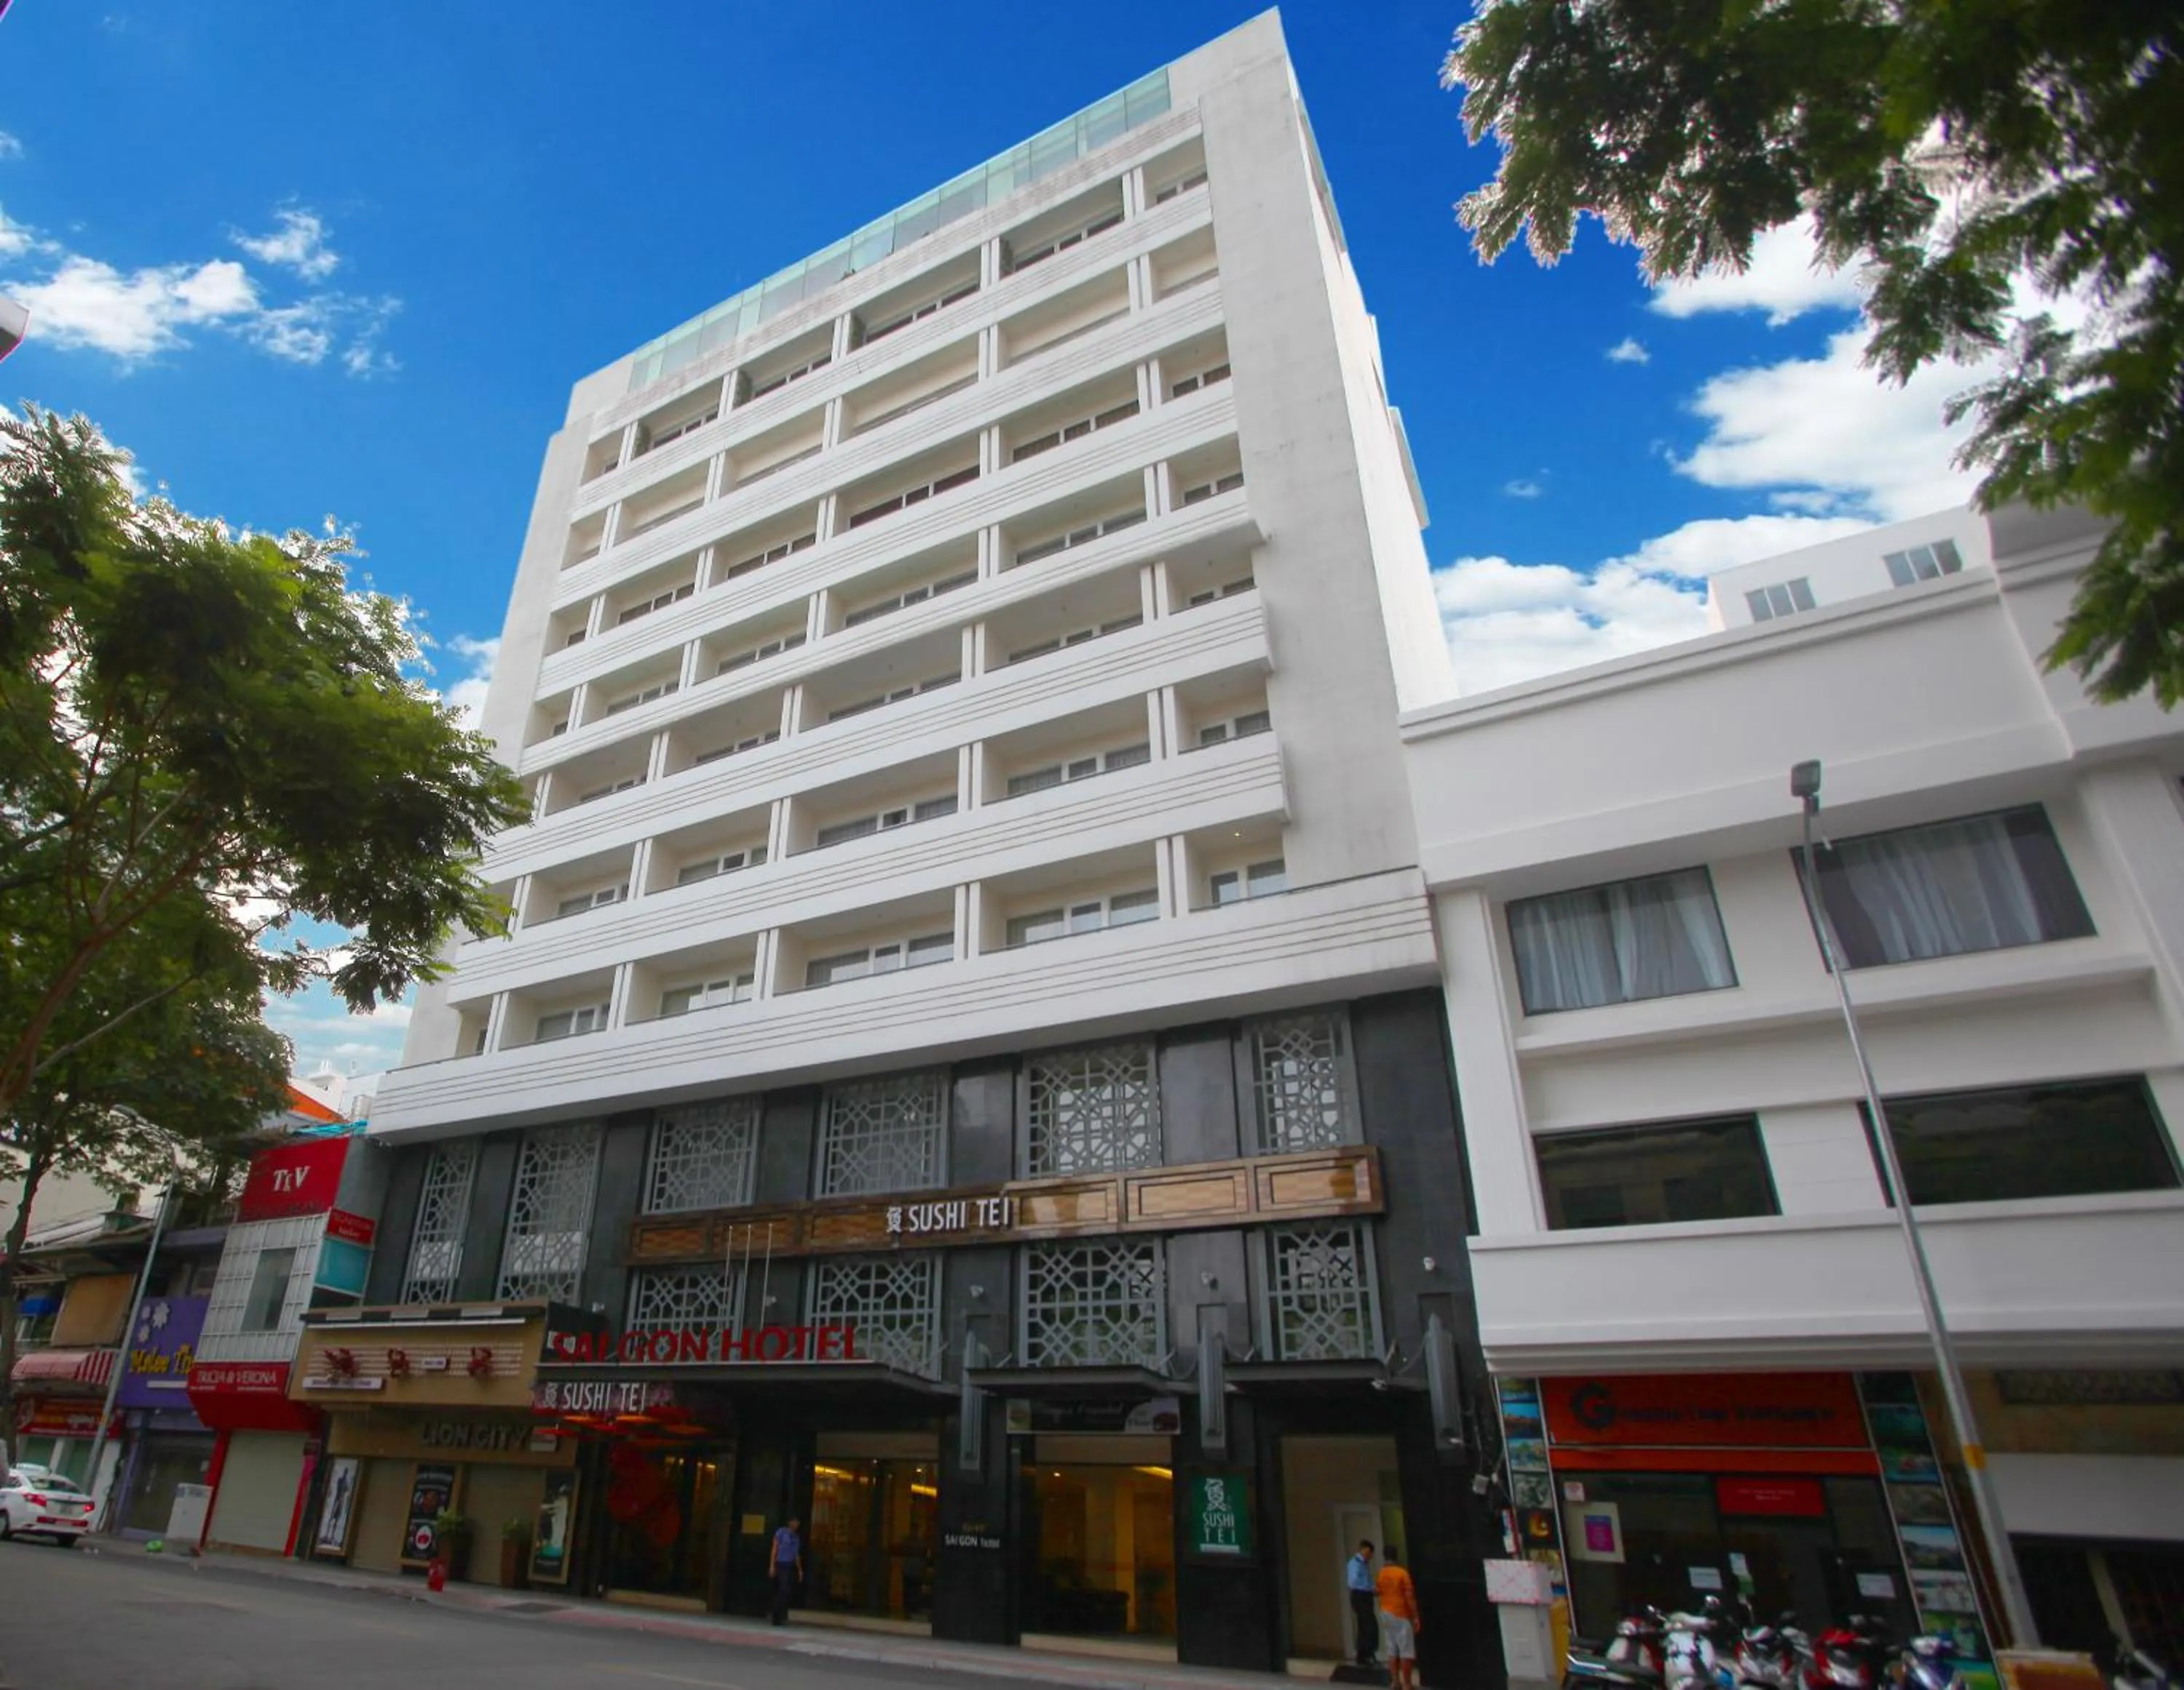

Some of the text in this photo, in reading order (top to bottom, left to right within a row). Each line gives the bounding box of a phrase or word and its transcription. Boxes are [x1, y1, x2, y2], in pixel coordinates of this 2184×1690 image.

[908, 1197, 1009, 1233] SUSHI TEI
[553, 1326, 864, 1365] SAIGON HOTEL
[563, 1382, 646, 1412] SUSHI TEI
[421, 1421, 529, 1449] LION CITY
[1202, 1511, 1235, 1528] SUSHI
[1203, 1527, 1235, 1544] TEI
